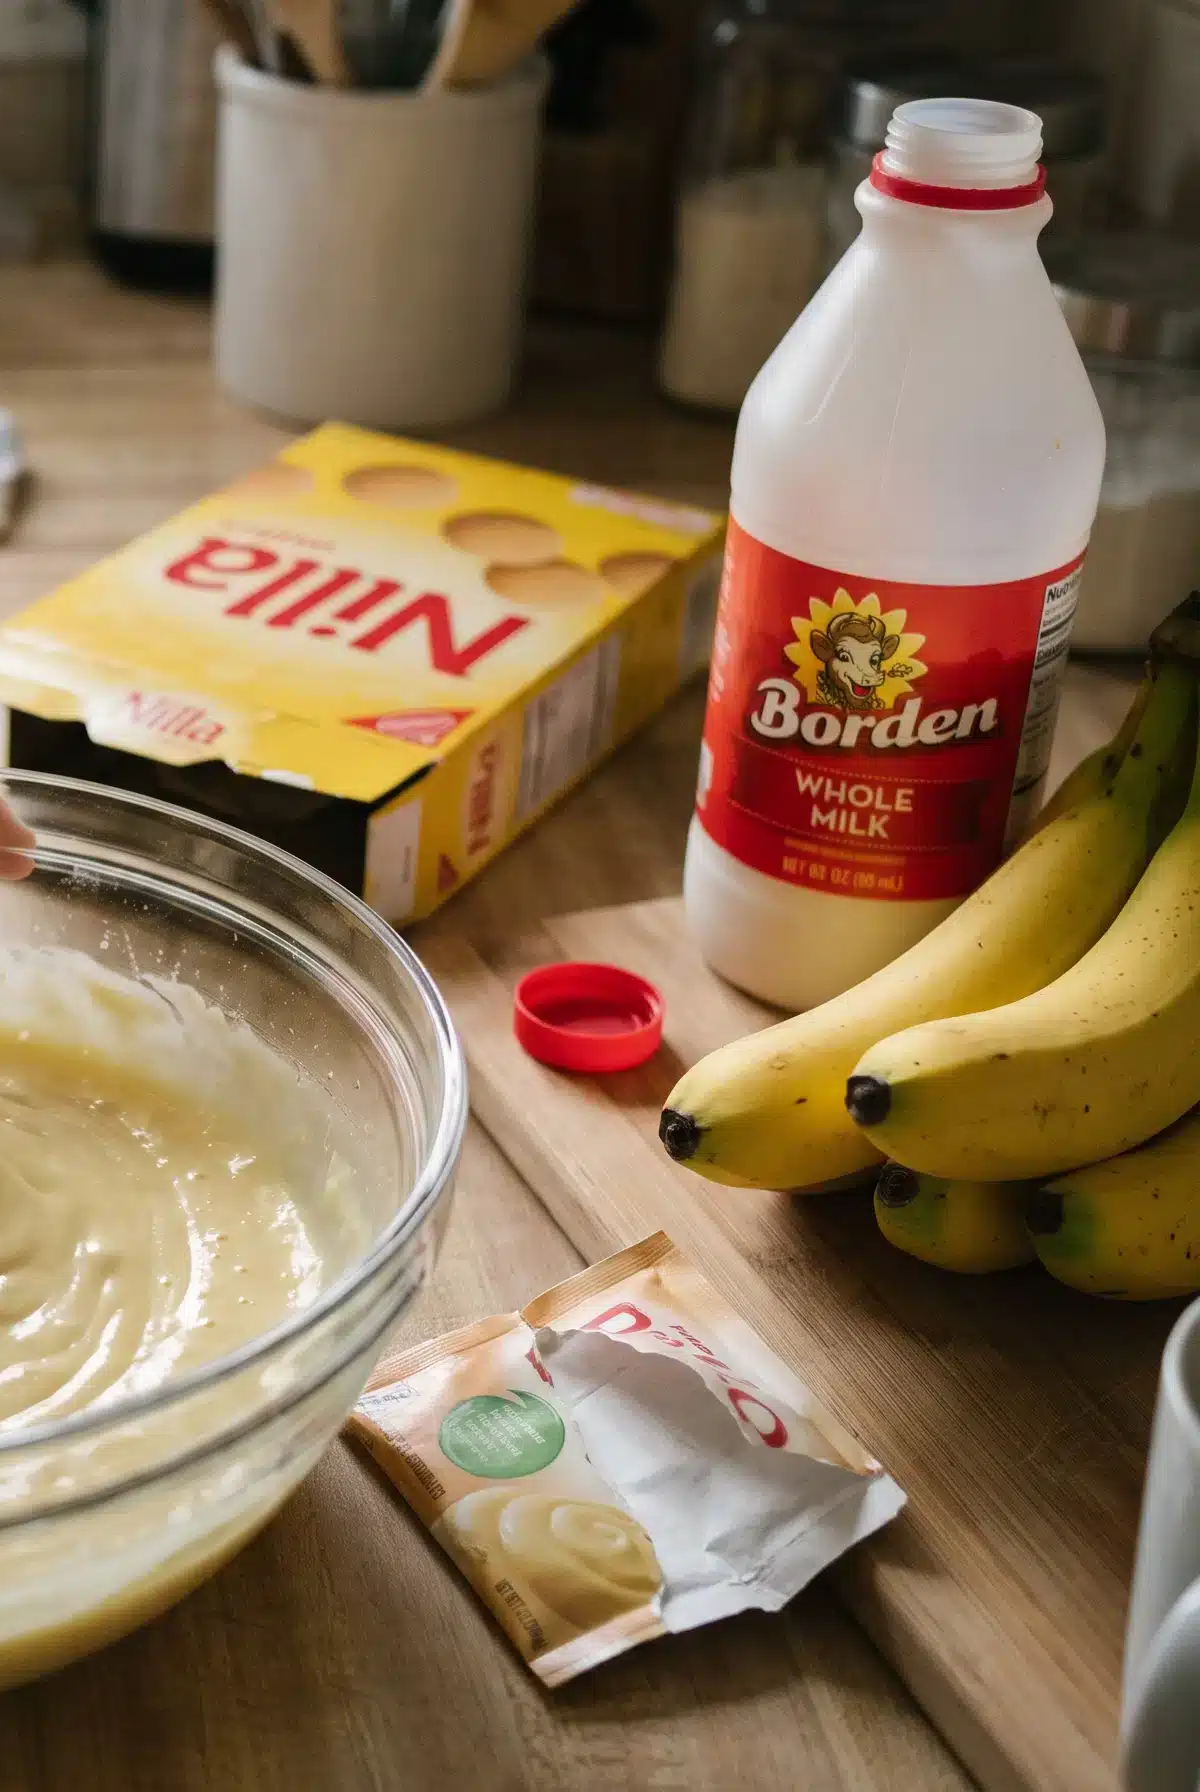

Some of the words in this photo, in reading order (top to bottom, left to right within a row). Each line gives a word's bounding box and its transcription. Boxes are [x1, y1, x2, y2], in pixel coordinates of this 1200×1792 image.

[163, 536, 530, 678] Nilla
[750, 677, 999, 749] Borden
[795, 769, 914, 813] WHOLE
[811, 805, 889, 839] MILK
